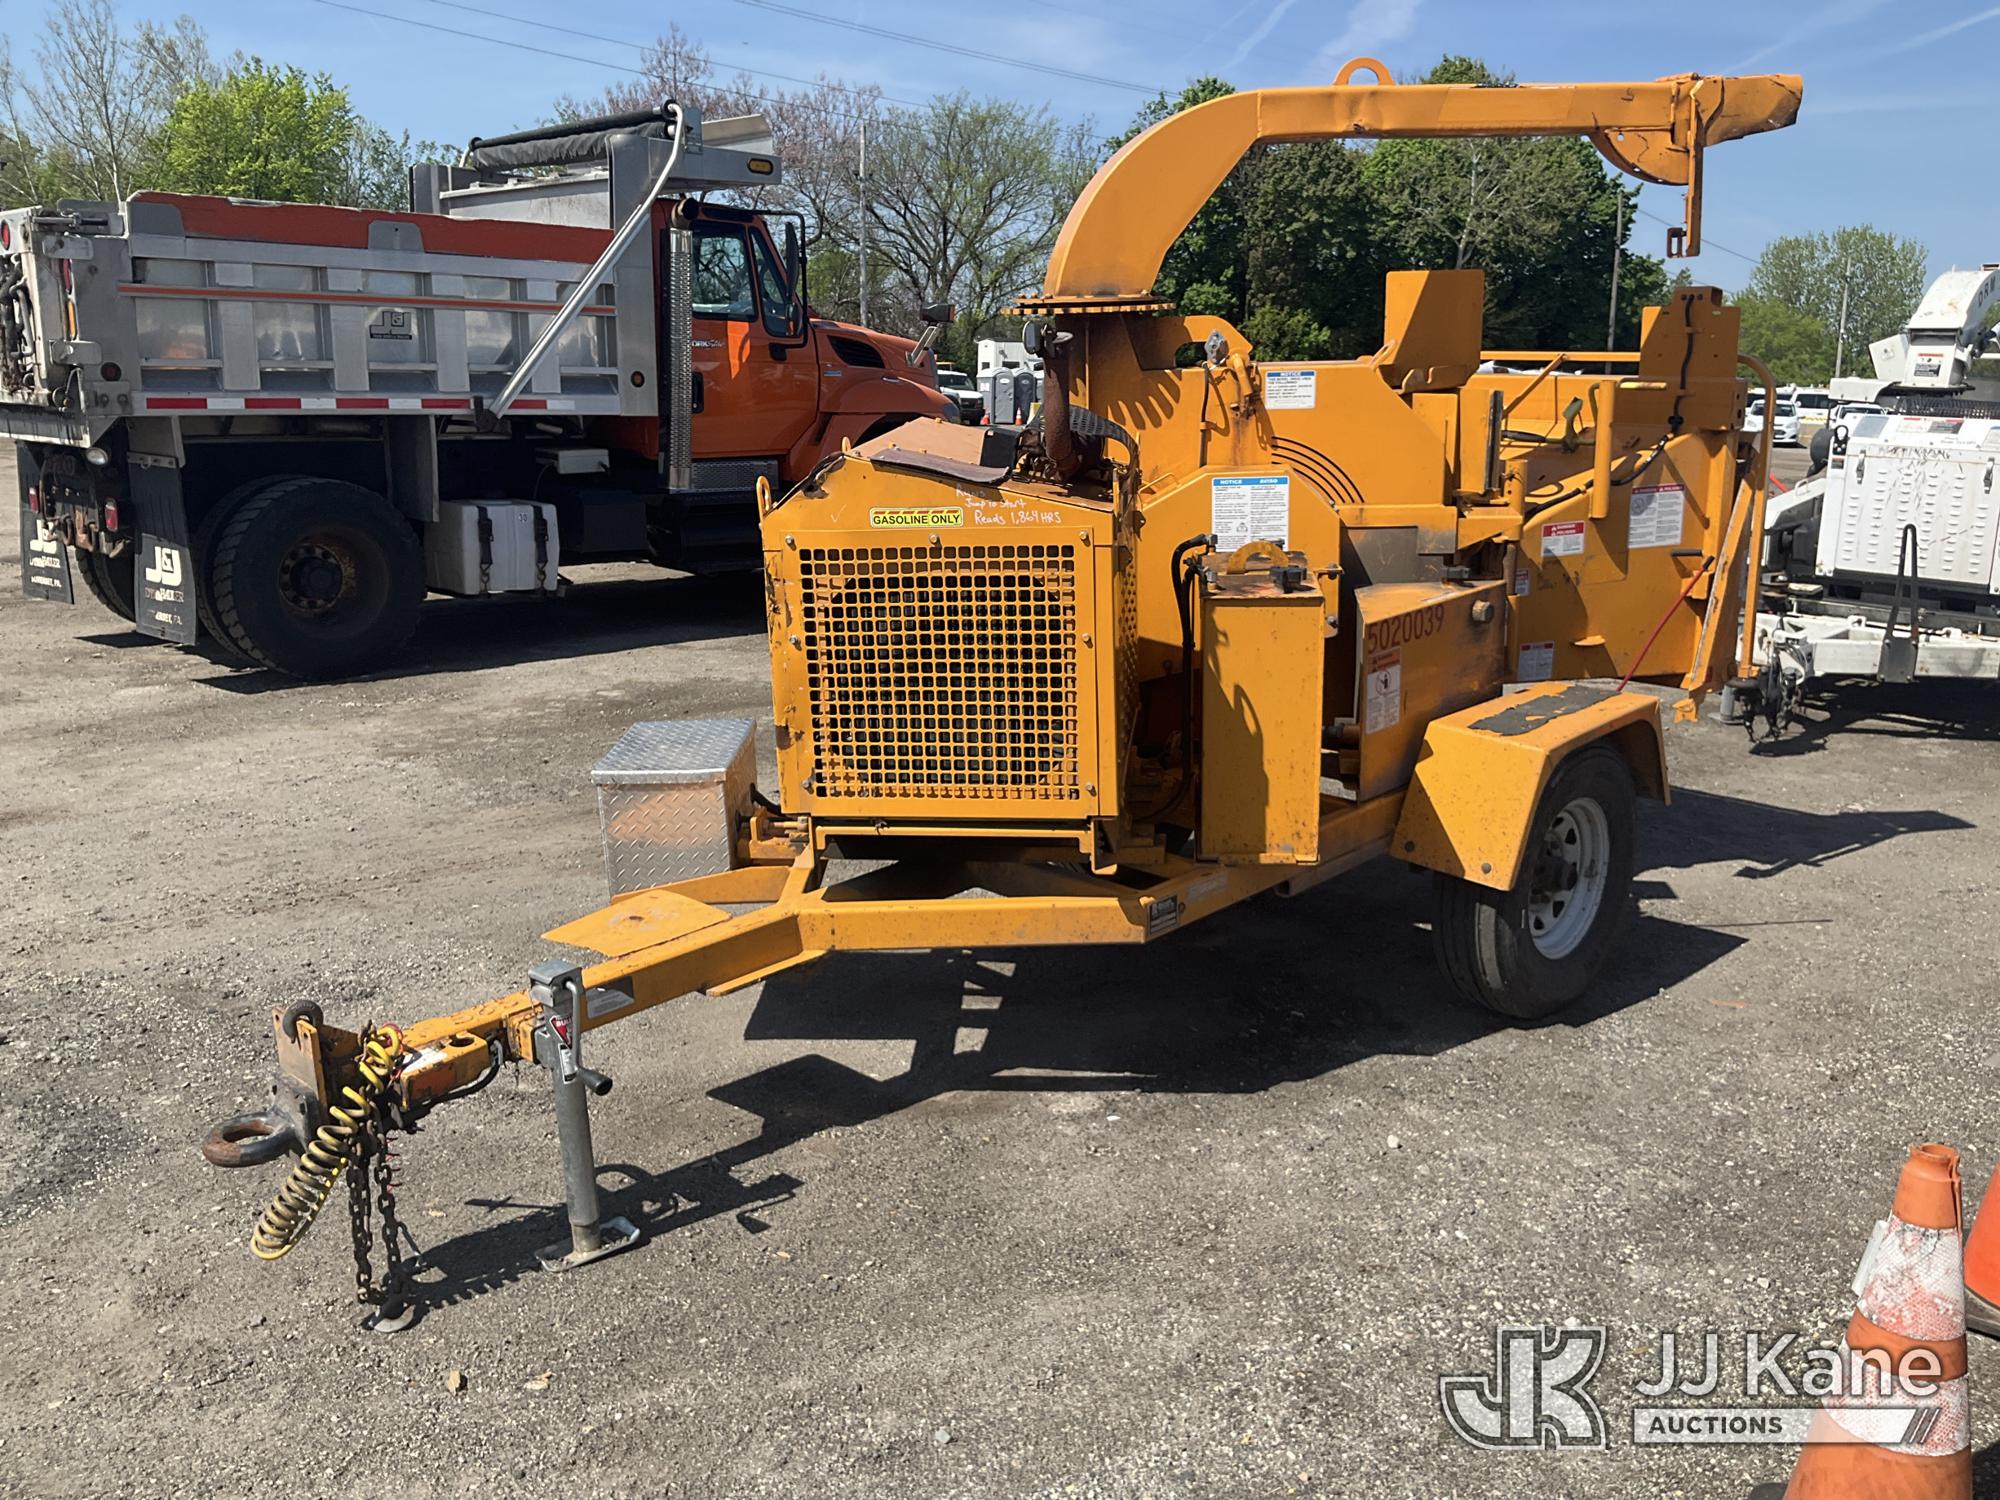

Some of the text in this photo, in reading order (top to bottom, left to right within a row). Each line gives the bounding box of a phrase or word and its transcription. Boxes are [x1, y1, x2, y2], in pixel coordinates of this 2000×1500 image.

[873, 514, 960, 525] GASOLINE ONLY
[974, 510, 1006, 525] Reads
[1040, 511, 1062, 524] HRS
[145, 546, 182, 587] J&J
[1368, 603, 1445, 654] 5020039
